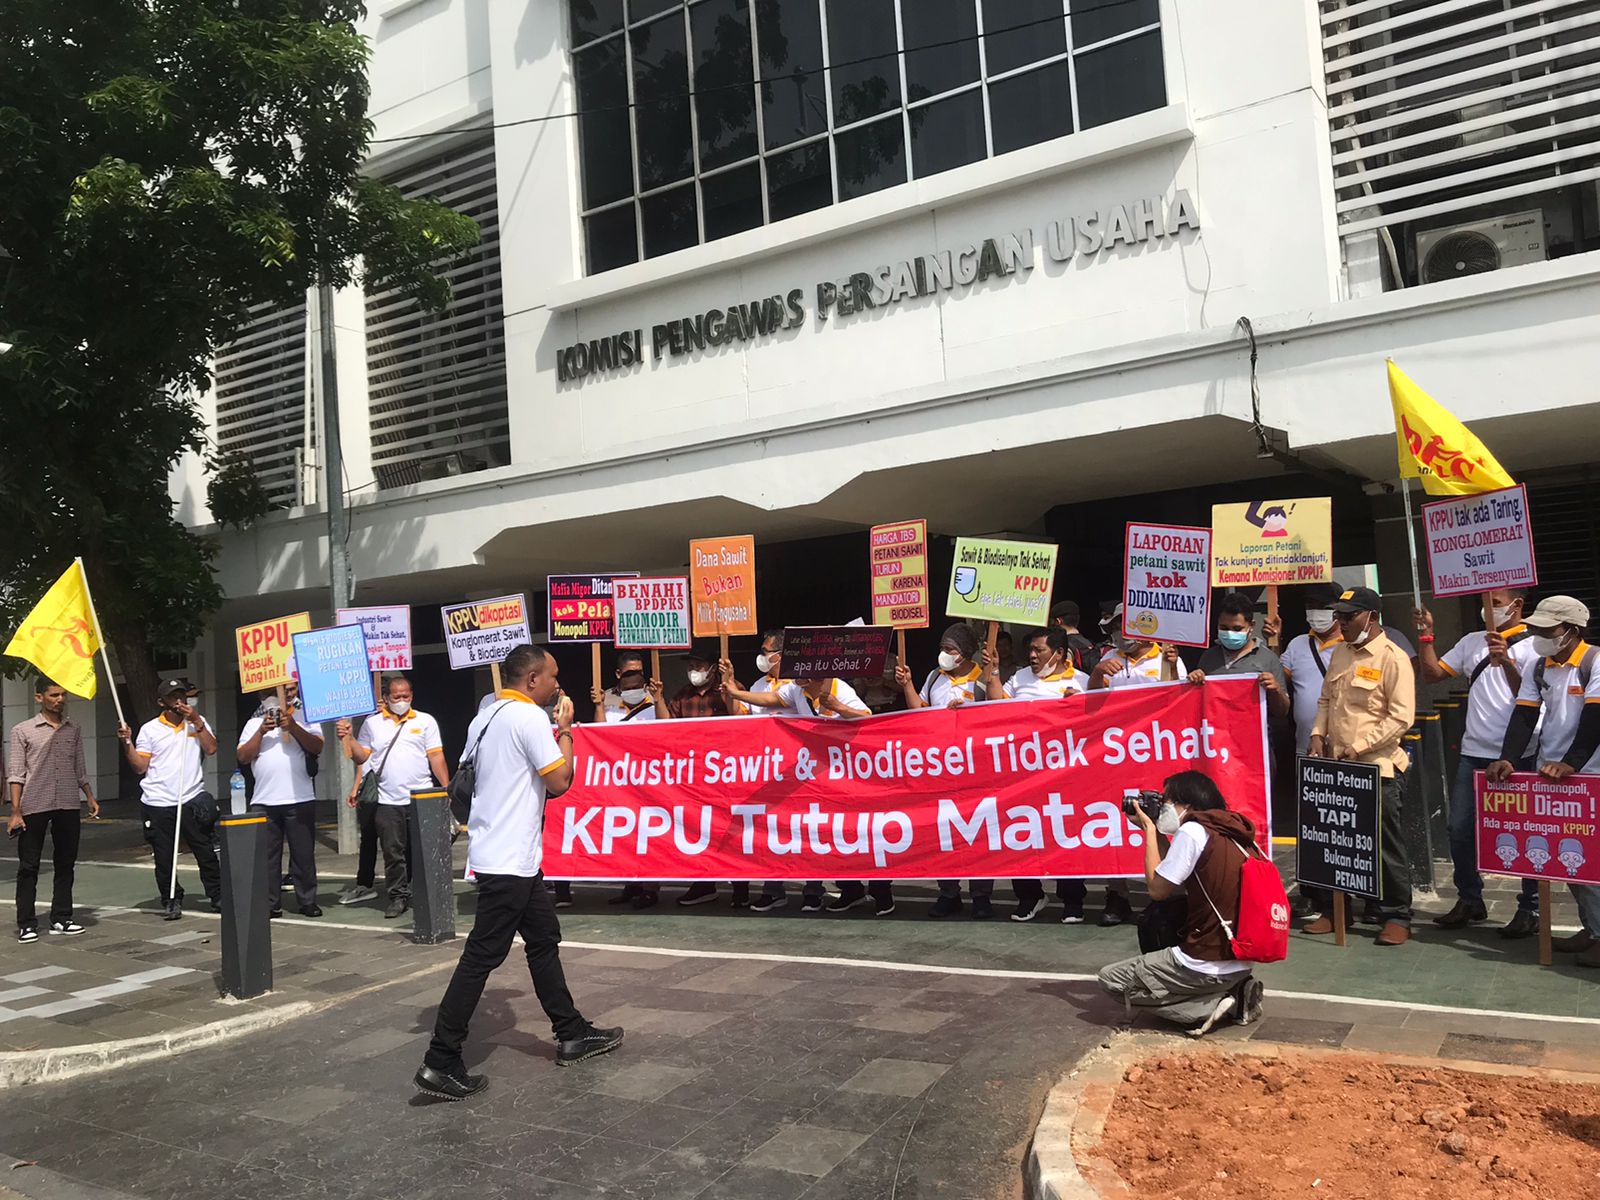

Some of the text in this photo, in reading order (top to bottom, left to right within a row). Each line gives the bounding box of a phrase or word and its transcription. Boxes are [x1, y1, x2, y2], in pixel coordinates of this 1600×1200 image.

[556, 189, 1201, 381] KOMISI PENGAWAS PERSAINGAN USAHA
[1429, 507, 1453, 532] KPPU
[1455, 504, 1471, 527] tak
[1473, 501, 1490, 522] ada
[1491, 496, 1523, 522] Taring,
[873, 530, 915, 545] HARGA TBS
[1133, 533, 1204, 554] LAPORAN
[1240, 539, 1302, 555] Laporan Petani
[1433, 524, 1524, 554] KONGLOMERAT
[696, 546, 748, 567] Dana Sawit
[874, 544, 923, 560] PETANI SAWIT
[960, 546, 977, 564] Sawit
[1020, 551, 1031, 568] Tak
[1031, 553, 1051, 572] Sehat,
[1214, 552, 1328, 569] Tak kunjung ditindaklanjuti,
[1464, 549, 1495, 568] Sawit
[875, 563, 900, 574] TURUN
[1130, 554, 1206, 573] petani sawit
[893, 577, 923, 588] KARENA
[1146, 571, 1187, 589] kok
[1218, 564, 1325, 583] Kemana Komisioner KPPU?
[1438, 572, 1471, 590] Makin
[1471, 563, 1531, 585] Tersenyum!
[551, 583, 570, 596] Mafia
[571, 582, 591, 598] Migor
[616, 583, 683, 598] BENAHI
[703, 574, 742, 596] Bukan
[1014, 575, 1049, 593] KPPU
[635, 598, 683, 610] BPDPKS
[875, 592, 919, 605] MANDATORI
[1128, 589, 1195, 613] DIDIAMKAN
[377, 615, 392, 623] Sawit
[446, 602, 523, 634] KPPU dikoptasi
[555, 601, 613, 618] kok Pela
[696, 602, 713, 623] Milik
[891, 608, 924, 620] BIODISEL
[618, 612, 679, 628] AKOMODIR
[241, 622, 289, 656] KPPU
[451, 626, 527, 650] Konglomerat Sawit
[554, 621, 588, 639] Monopoli
[589, 621, 610, 635] KPPU
[618, 629, 661, 644] PERWAKILAN
[663, 628, 687, 644] PETANI
[317, 641, 363, 661] RUGIKAN
[469, 650, 476, 661] &
[243, 654, 274, 672] Masuk
[794, 662, 812, 676] apa
[815, 659, 829, 671] itu
[831, 657, 861, 671] Sehat
[245, 664, 287, 685] Angin!!
[339, 670, 368, 686] KPPU
[327, 689, 349, 703] WAJIB
[585, 750, 695, 787] Industri
[704, 746, 784, 783] Sawit
[795, 747, 818, 780] &
[828, 737, 975, 781] Biodiesel
[985, 729, 1088, 773] Tidak
[1102, 718, 1229, 765] Sehat,
[1303, 766, 1372, 791] Klaim Petani
[1302, 787, 1359, 810] Sejahtera,
[1531, 781, 1590, 797] dimonopoli,
[1483, 792, 1527, 814] KPPU
[1534, 795, 1582, 818] Diam
[1318, 808, 1356, 828] TAPI
[1483, 817, 1596, 837] Ada apa dengan KPPU?
[561, 789, 1144, 868] KPPU Tutup Mata!
[1302, 825, 1373, 852] Bahan Baku B30
[1323, 848, 1373, 871] Bukan dari
[1335, 870, 1367, 890] PETANI
